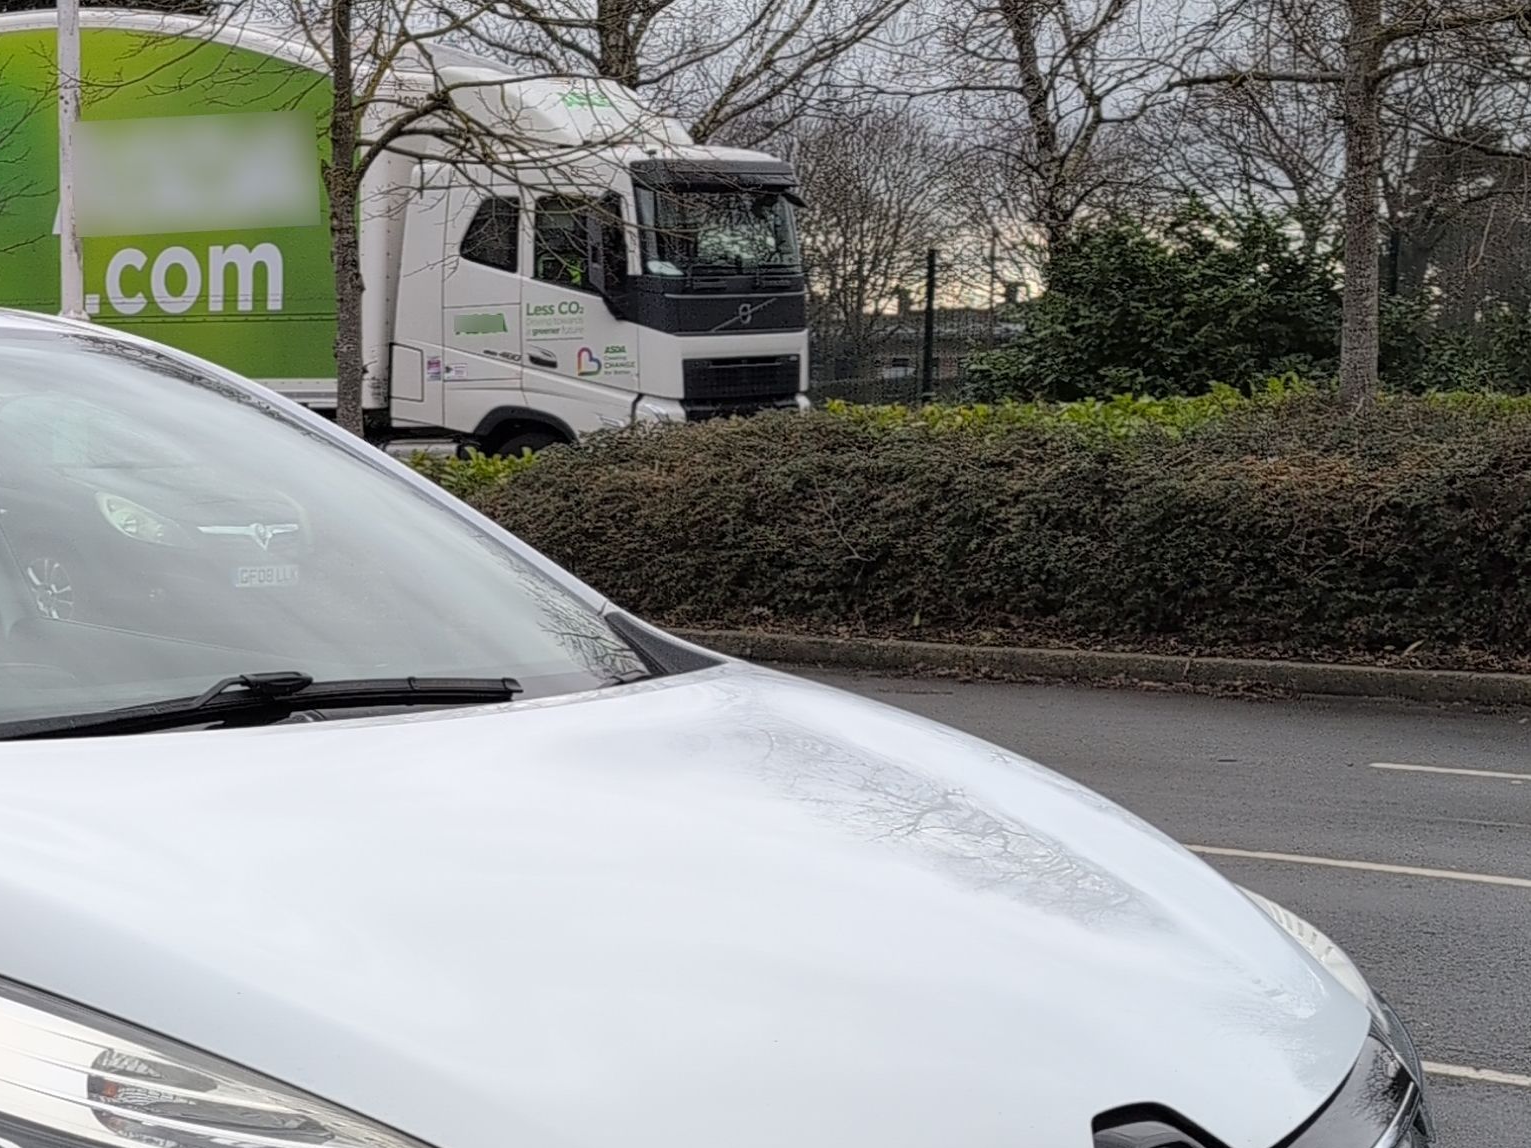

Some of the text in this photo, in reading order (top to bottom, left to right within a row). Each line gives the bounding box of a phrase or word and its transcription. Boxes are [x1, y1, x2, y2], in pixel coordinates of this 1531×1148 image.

[84, 242, 284, 315] .com
[526, 303, 555, 316] Less
[604, 346, 627, 354] ASDA
